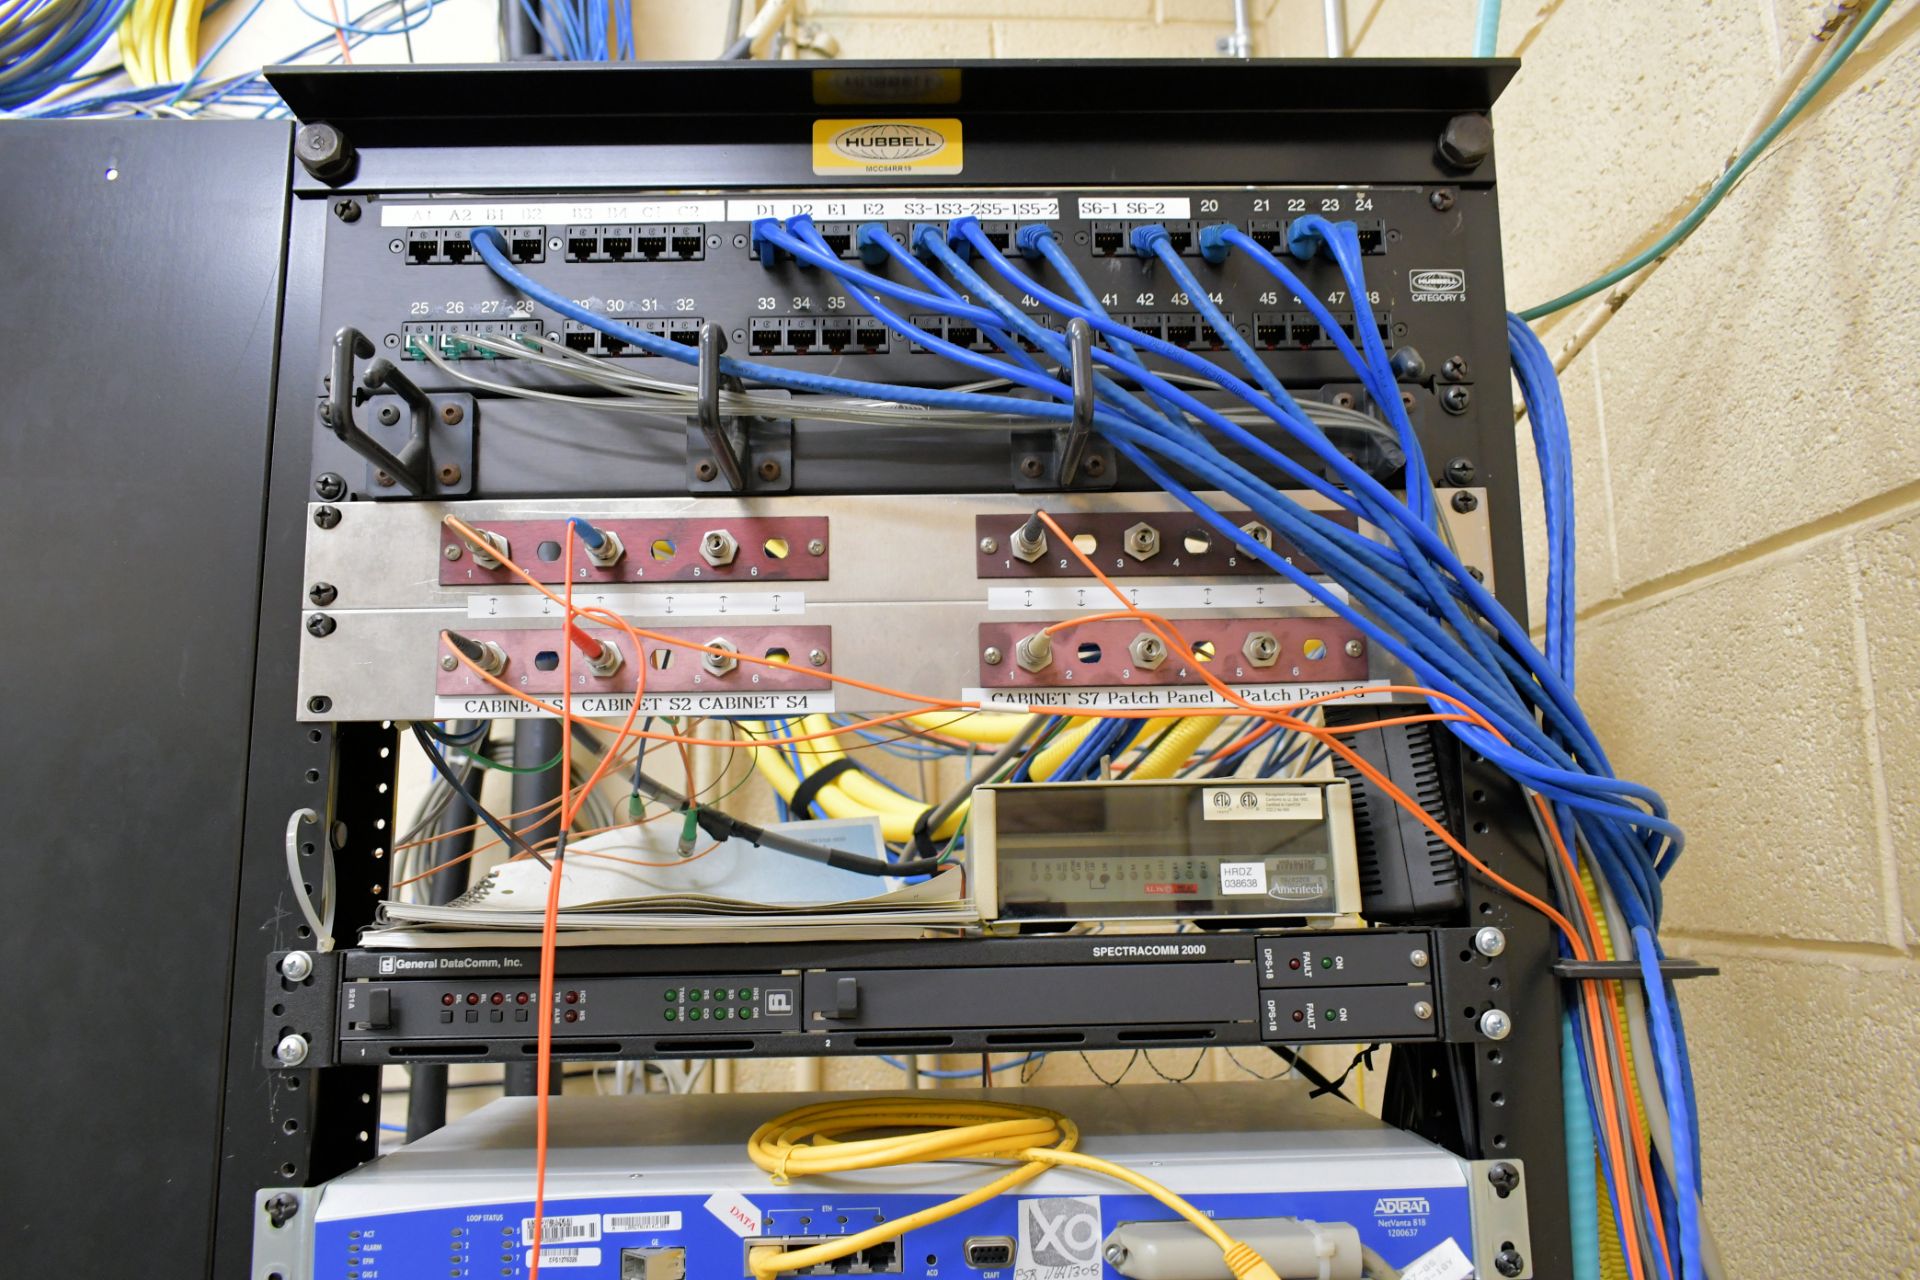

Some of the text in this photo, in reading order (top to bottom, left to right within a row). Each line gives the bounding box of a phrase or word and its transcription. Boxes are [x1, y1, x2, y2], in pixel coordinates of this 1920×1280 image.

[845, 136, 936, 148] HUBBELL
[756, 202, 1059, 216] D1 D2 E1 E2 S3-1 S3-2 S5-1 S5-2
[1081, 201, 1165, 215] S6-1 S6-2
[1200, 198, 1373, 212] 20 21 22 23 24
[449, 208, 472, 222] A2
[486, 207, 505, 221] B1
[520, 207, 543, 221] B2
[571, 206, 593, 220] B3
[641, 205, 662, 219] C1
[677, 204, 700, 218] C2
[757, 297, 776, 310] 33
[792, 296, 811, 310] 34
[827, 296, 846, 309] 35
[1101, 293, 1119, 306] 41
[1136, 293, 1154, 306] 42
[1171, 292, 1189, 306] 43
[1259, 292, 1277, 305] 45
[1328, 291, 1345, 304] 47
[1411, 293, 1466, 302] CATEGORY 5
[410, 301, 429, 315] 25
[445, 301, 464, 314] 26
[480, 300, 500, 314] 27
[516, 300, 535, 313] 28
[606, 299, 625, 312] 30
[641, 298, 659, 312] 31
[676, 298, 695, 311] 32
[1004, 560, 1011, 569] 1
[1060, 559, 1068, 569] 2
[1116, 559, 1124, 568] 3
[1172, 558, 1180, 567] 4
[1229, 557, 1236, 567] 5
[466, 569, 473, 578] 1
[579, 568, 587, 578] 3
[636, 568, 644, 577] 4
[693, 567, 701, 576] 5
[750, 567, 758, 576] 6
[520, 676, 528, 685] 2
[578, 675, 586, 684] 3
[694, 675, 701, 684] 5
[752, 674, 759, 684] 6
[1008, 666, 1300, 680] 1 2 3 4 5 6
[581, 697, 662, 712] CABINET
[669, 696, 692, 711] S2
[698, 695, 779, 711] CABINET
[786, 694, 809, 709] S4
[991, 691, 1072, 705] CABINET
[1077, 691, 1100, 706] S7
[1108, 690, 1160, 705] Patch
[1167, 690, 1214, 704] Panel
[1240, 688, 1291, 702] Patch
[1224, 867, 1253, 877] HRDZ
[1224, 878, 1258, 889] 038638
[1092, 944, 1207, 957] SPECTRACOMM 2000
[396, 957, 523, 970] General DataComm, Inc.
[1263, 948, 1274, 979] DPS-18
[1303, 951, 1313, 978] FAULT
[1335, 956, 1344, 970] ON
[505, 993, 511, 1002] LT
[555, 992, 561, 1004] TM
[1267, 1000, 1277, 1031] DPS-18
[1306, 1003, 1316, 1030] FAULT
[1339, 1008, 1347, 1022] ON
[825, 1039, 831, 1047] 2
[1373, 1197, 1430, 1216] ADTRAN
[466, 1214, 504, 1222] LOOP STATUS
[729, 1205, 757, 1232] DATA
[1377, 1218, 1426, 1228] NetVanta 818
[363, 1230, 375, 1239] ACT
[1030, 1199, 1098, 1264] XO
[1387, 1229, 1418, 1237] 1200637
[362, 1243, 383, 1251] ALARM
[361, 1271, 373, 1279] GIG
[983, 1271, 1000, 1279] CRAFT
